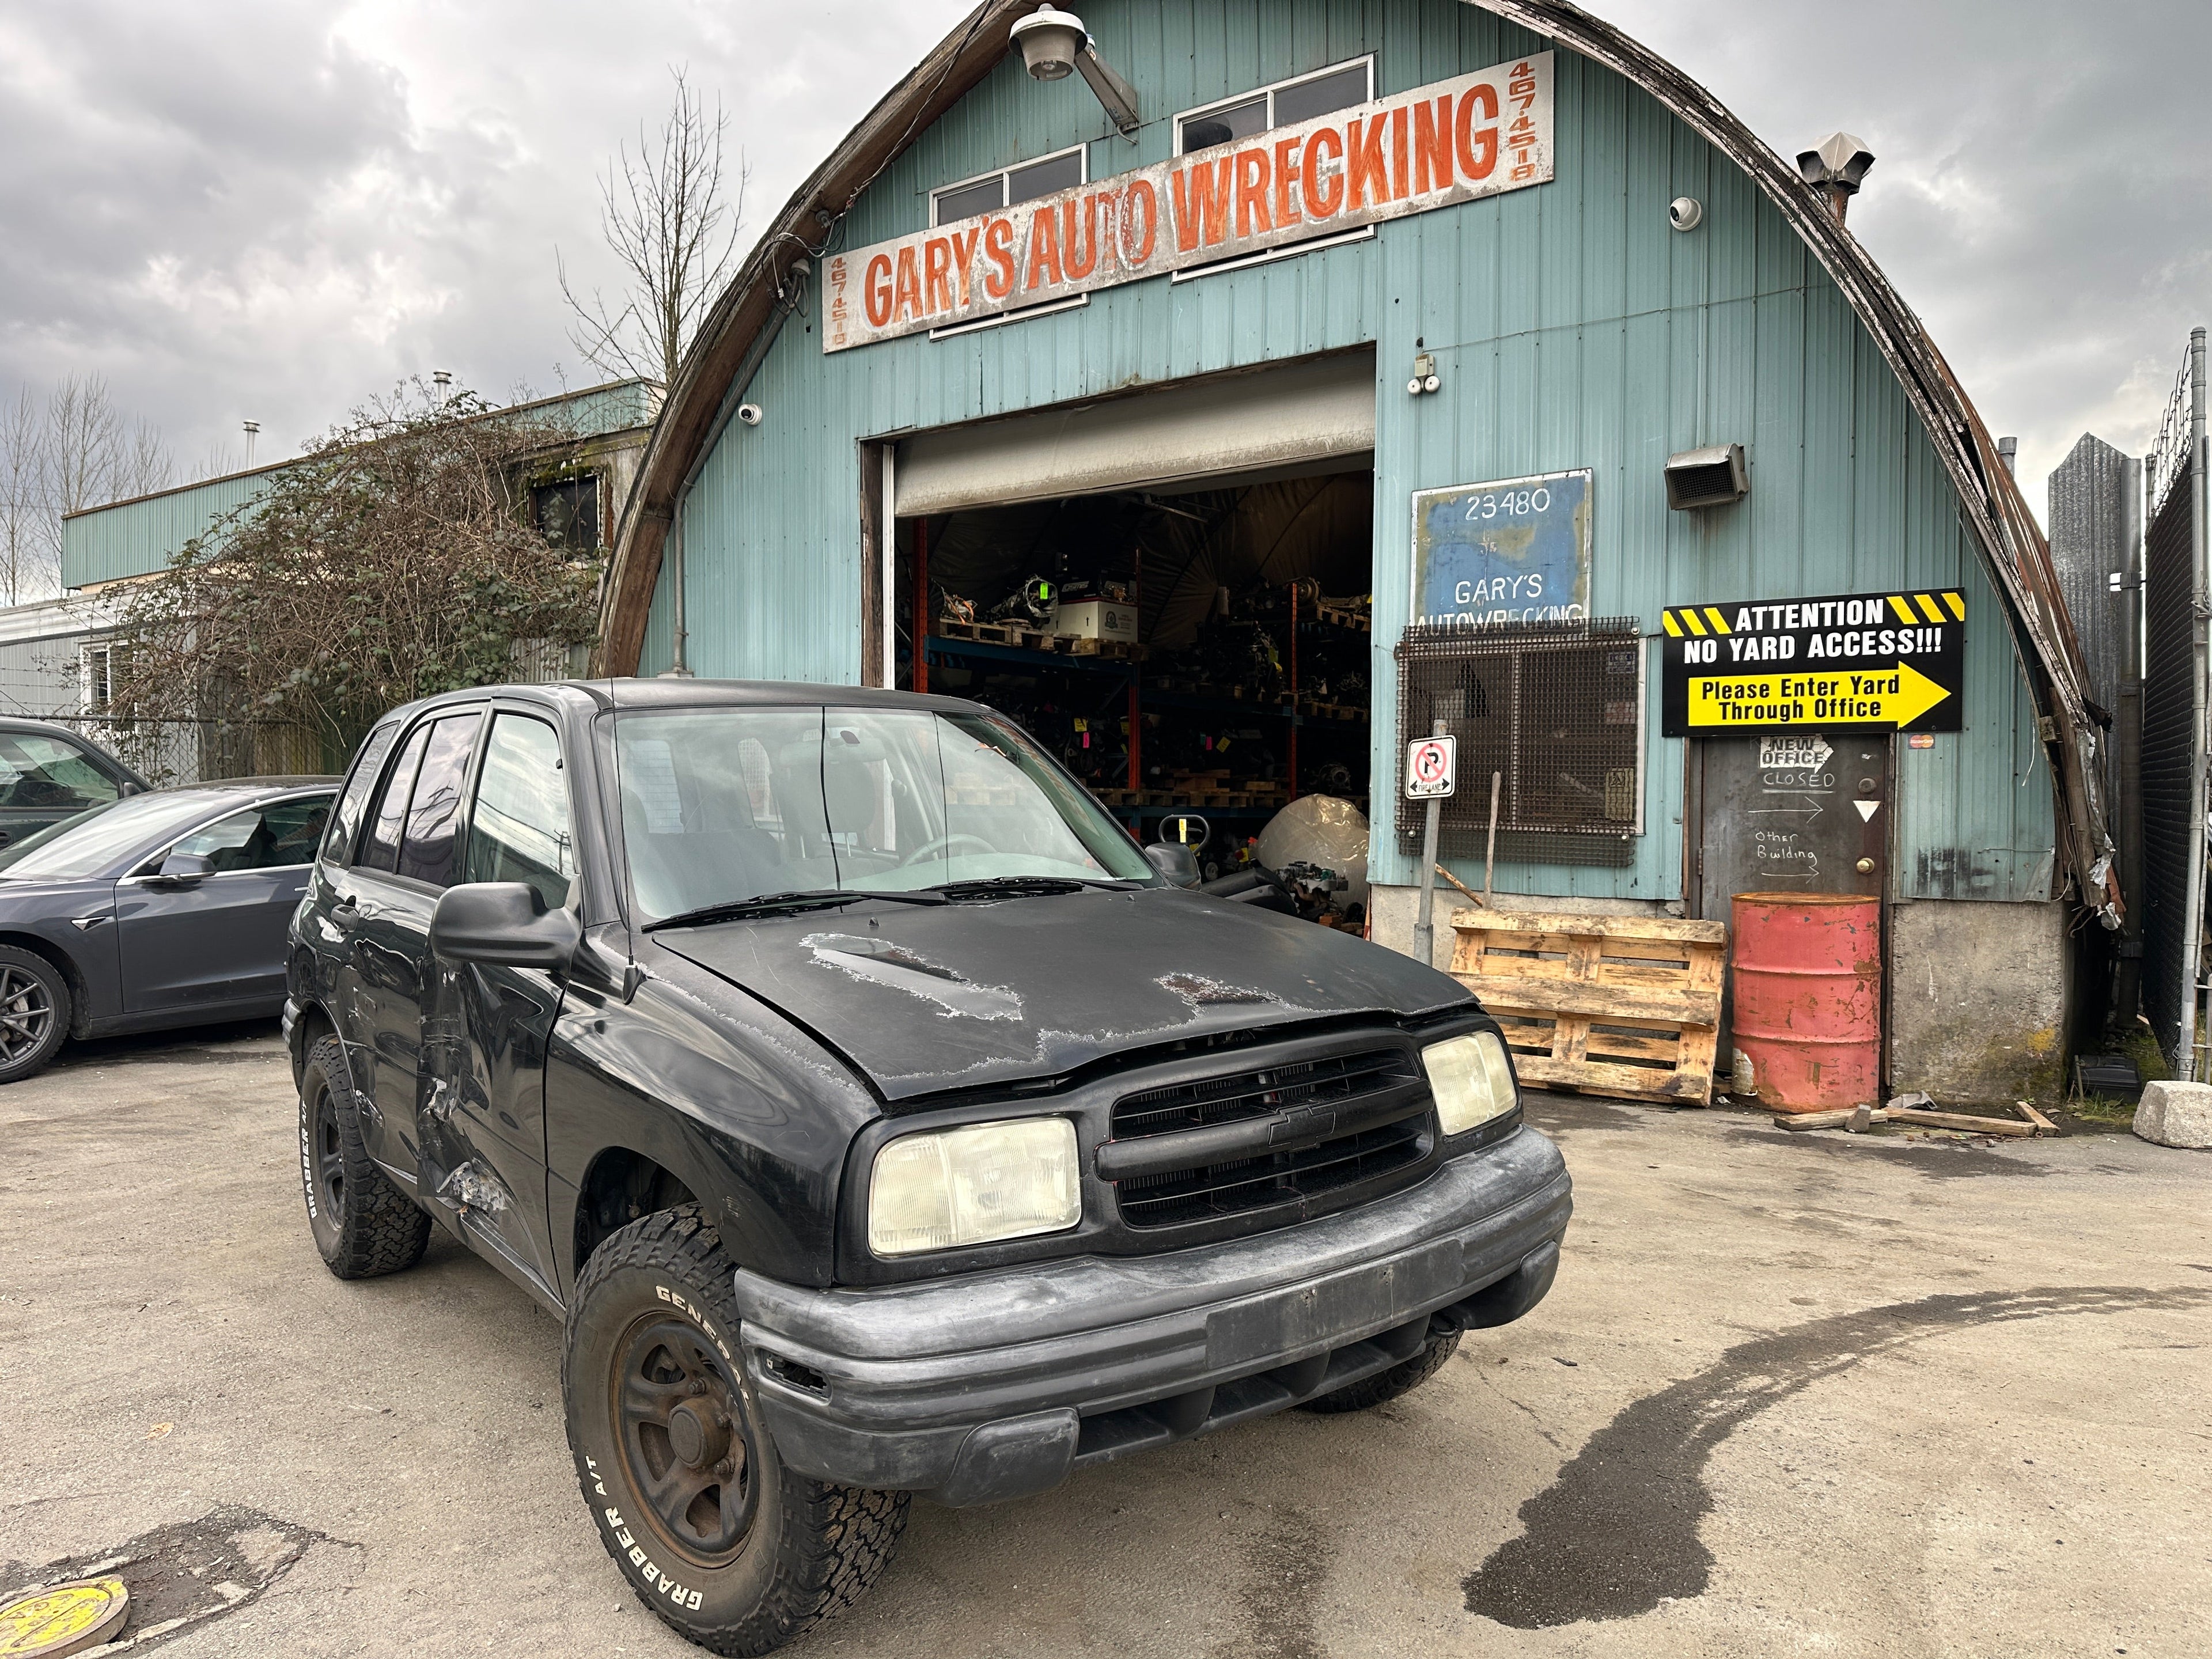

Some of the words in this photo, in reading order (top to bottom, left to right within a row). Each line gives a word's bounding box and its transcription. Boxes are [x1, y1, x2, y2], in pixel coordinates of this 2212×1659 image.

[863, 215, 1015, 328] GARY'S
[1027, 179, 1157, 289] AUTO
[1171, 83, 1499, 252] WRECKING
[1465, 488, 1551, 521] 23480
[1455, 573, 1543, 604] GARY'S
[1735, 599, 1884, 632] ATTENTION
[1684, 639, 1717, 664] NO
[1729, 635, 1796, 662] YARD
[1807, 627, 1942, 658] ACCESS!!!
[1702, 681, 1770, 700] Please
[1781, 677, 1839, 698] Enter
[1850, 674, 1900, 695] Yard
[1718, 699, 1804, 722] Through
[1814, 698, 1882, 718] Office
[1762, 752, 1825, 764] OFFICE
[1771, 738, 1815, 751] NEW
[1763, 772, 1835, 787] CLOSED
[1757, 844, 1817, 868] Building
[301, 1127, 318, 1219] GRABBER
[585, 1455, 607, 1496] A/T
[605, 1506, 703, 1611] GRABBER
